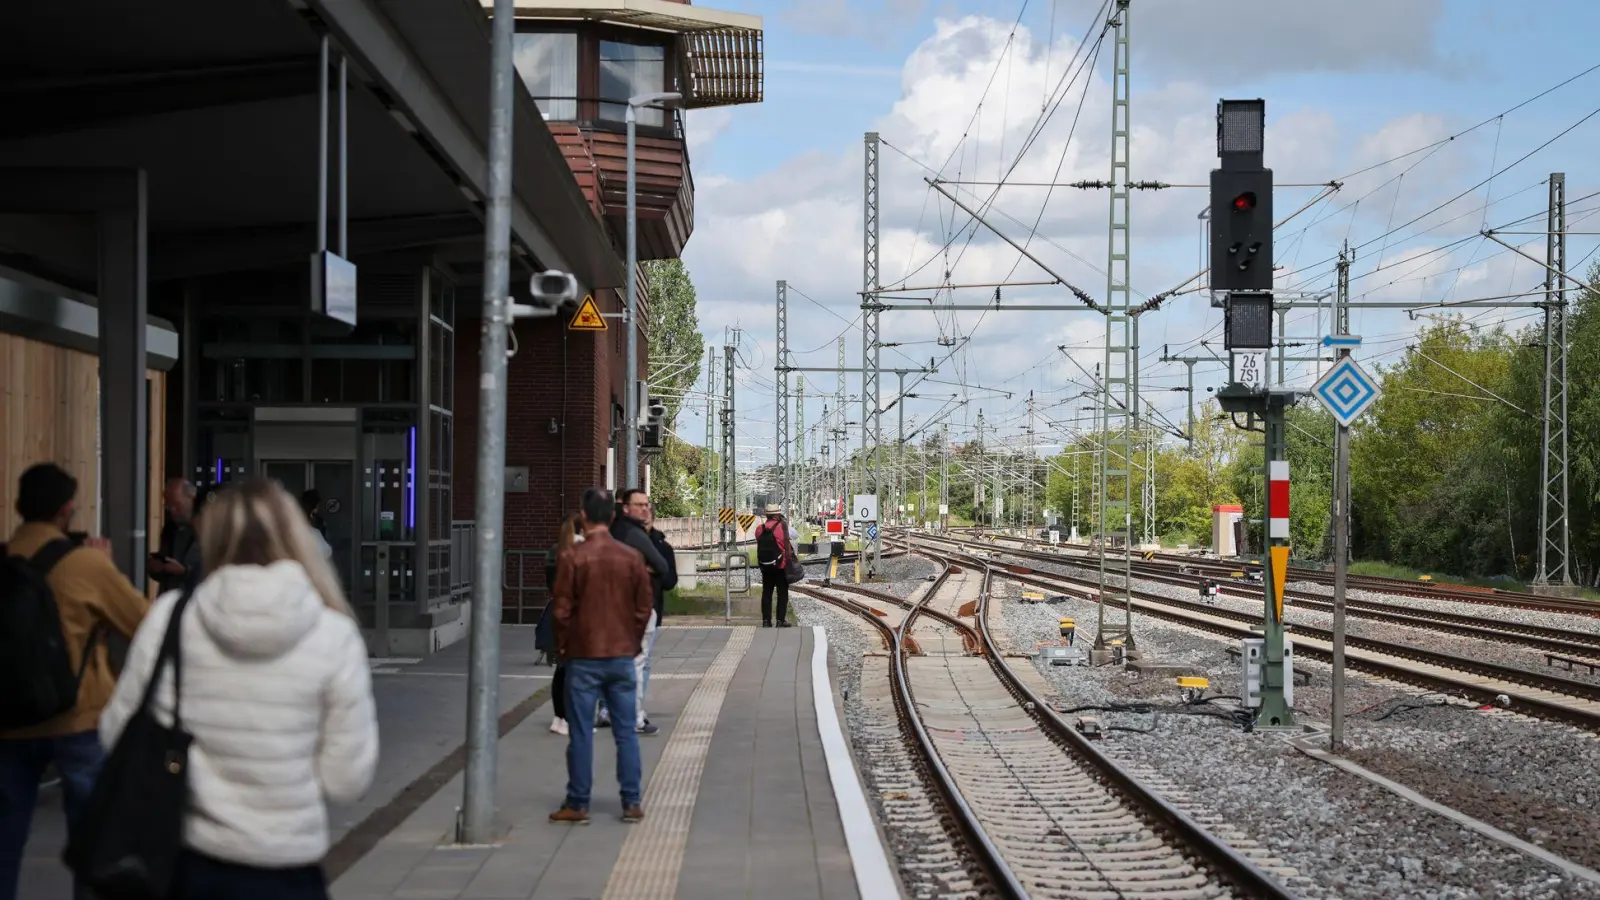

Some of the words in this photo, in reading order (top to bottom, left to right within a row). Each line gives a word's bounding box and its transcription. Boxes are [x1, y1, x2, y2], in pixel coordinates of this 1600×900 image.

[1243, 355, 1256, 368] 26
[1240, 369, 1258, 381] ZS1
[861, 508, 868, 518] 0
